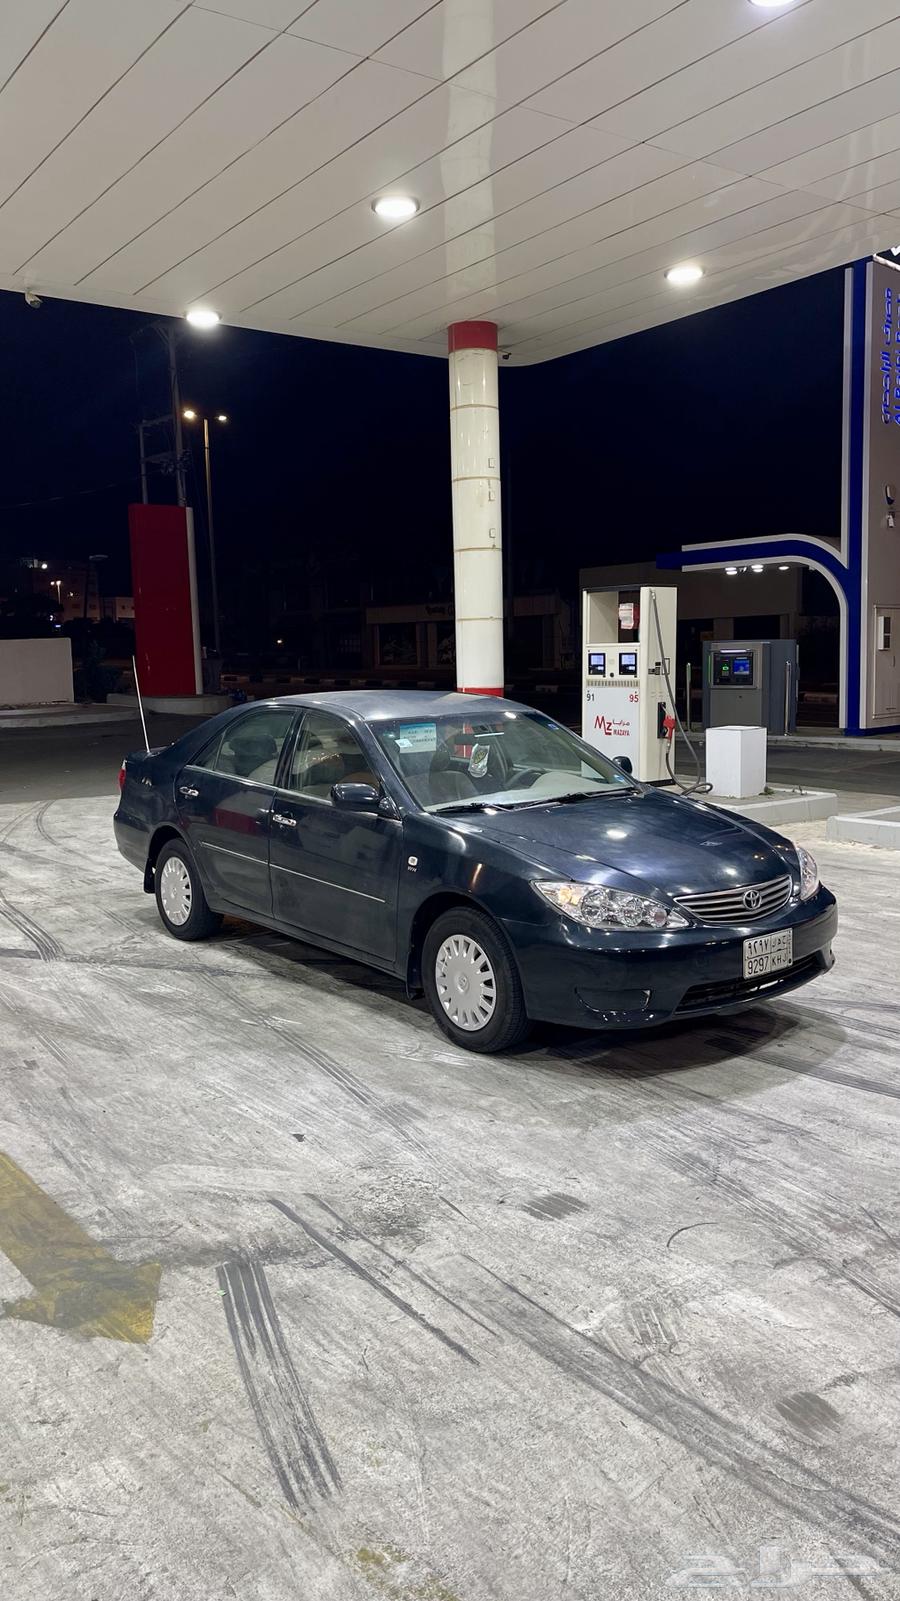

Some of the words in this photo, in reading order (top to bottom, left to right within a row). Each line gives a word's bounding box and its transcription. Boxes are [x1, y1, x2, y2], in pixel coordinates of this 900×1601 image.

[586, 693, 595, 701] 91
[629, 694, 639, 703] 95
[747, 956, 769, 975] 9297
